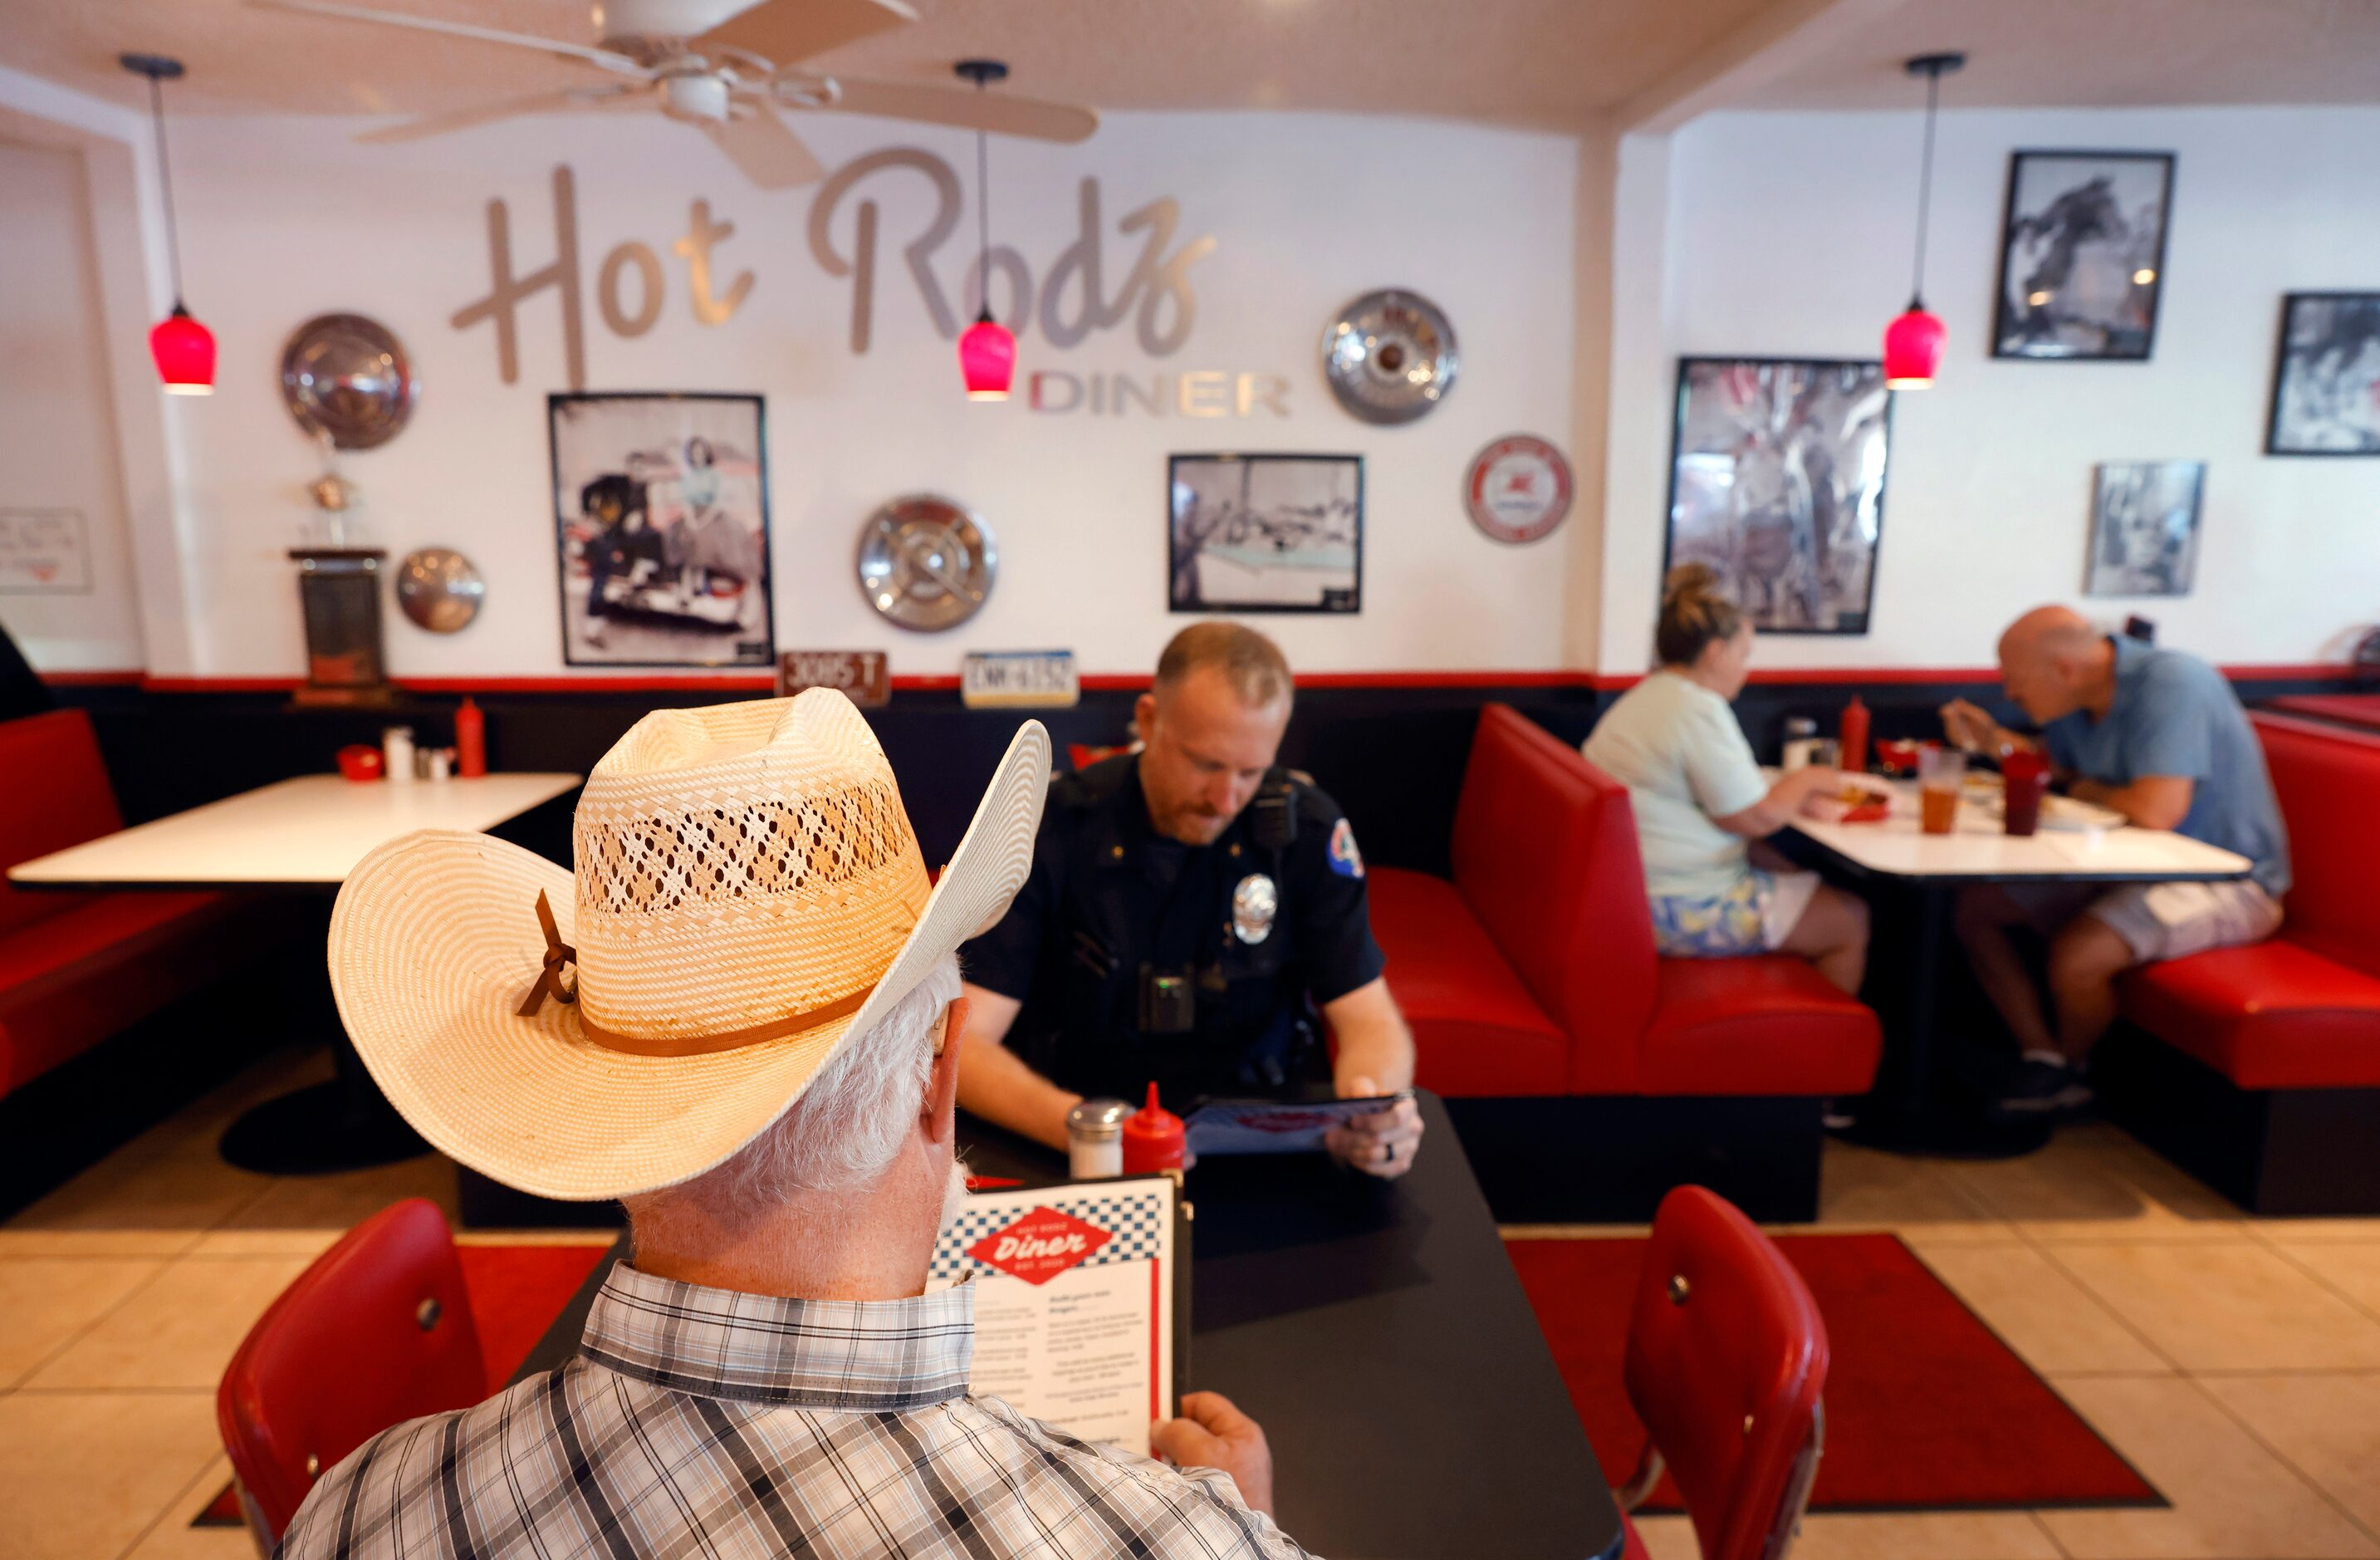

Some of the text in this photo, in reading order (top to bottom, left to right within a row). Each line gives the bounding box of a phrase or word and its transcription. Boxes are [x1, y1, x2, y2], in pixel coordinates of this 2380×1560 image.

[451, 145, 1217, 392] Hot Rodz
[1029, 370, 1293, 419] DINER
[993, 1232, 1087, 1262] Diner
